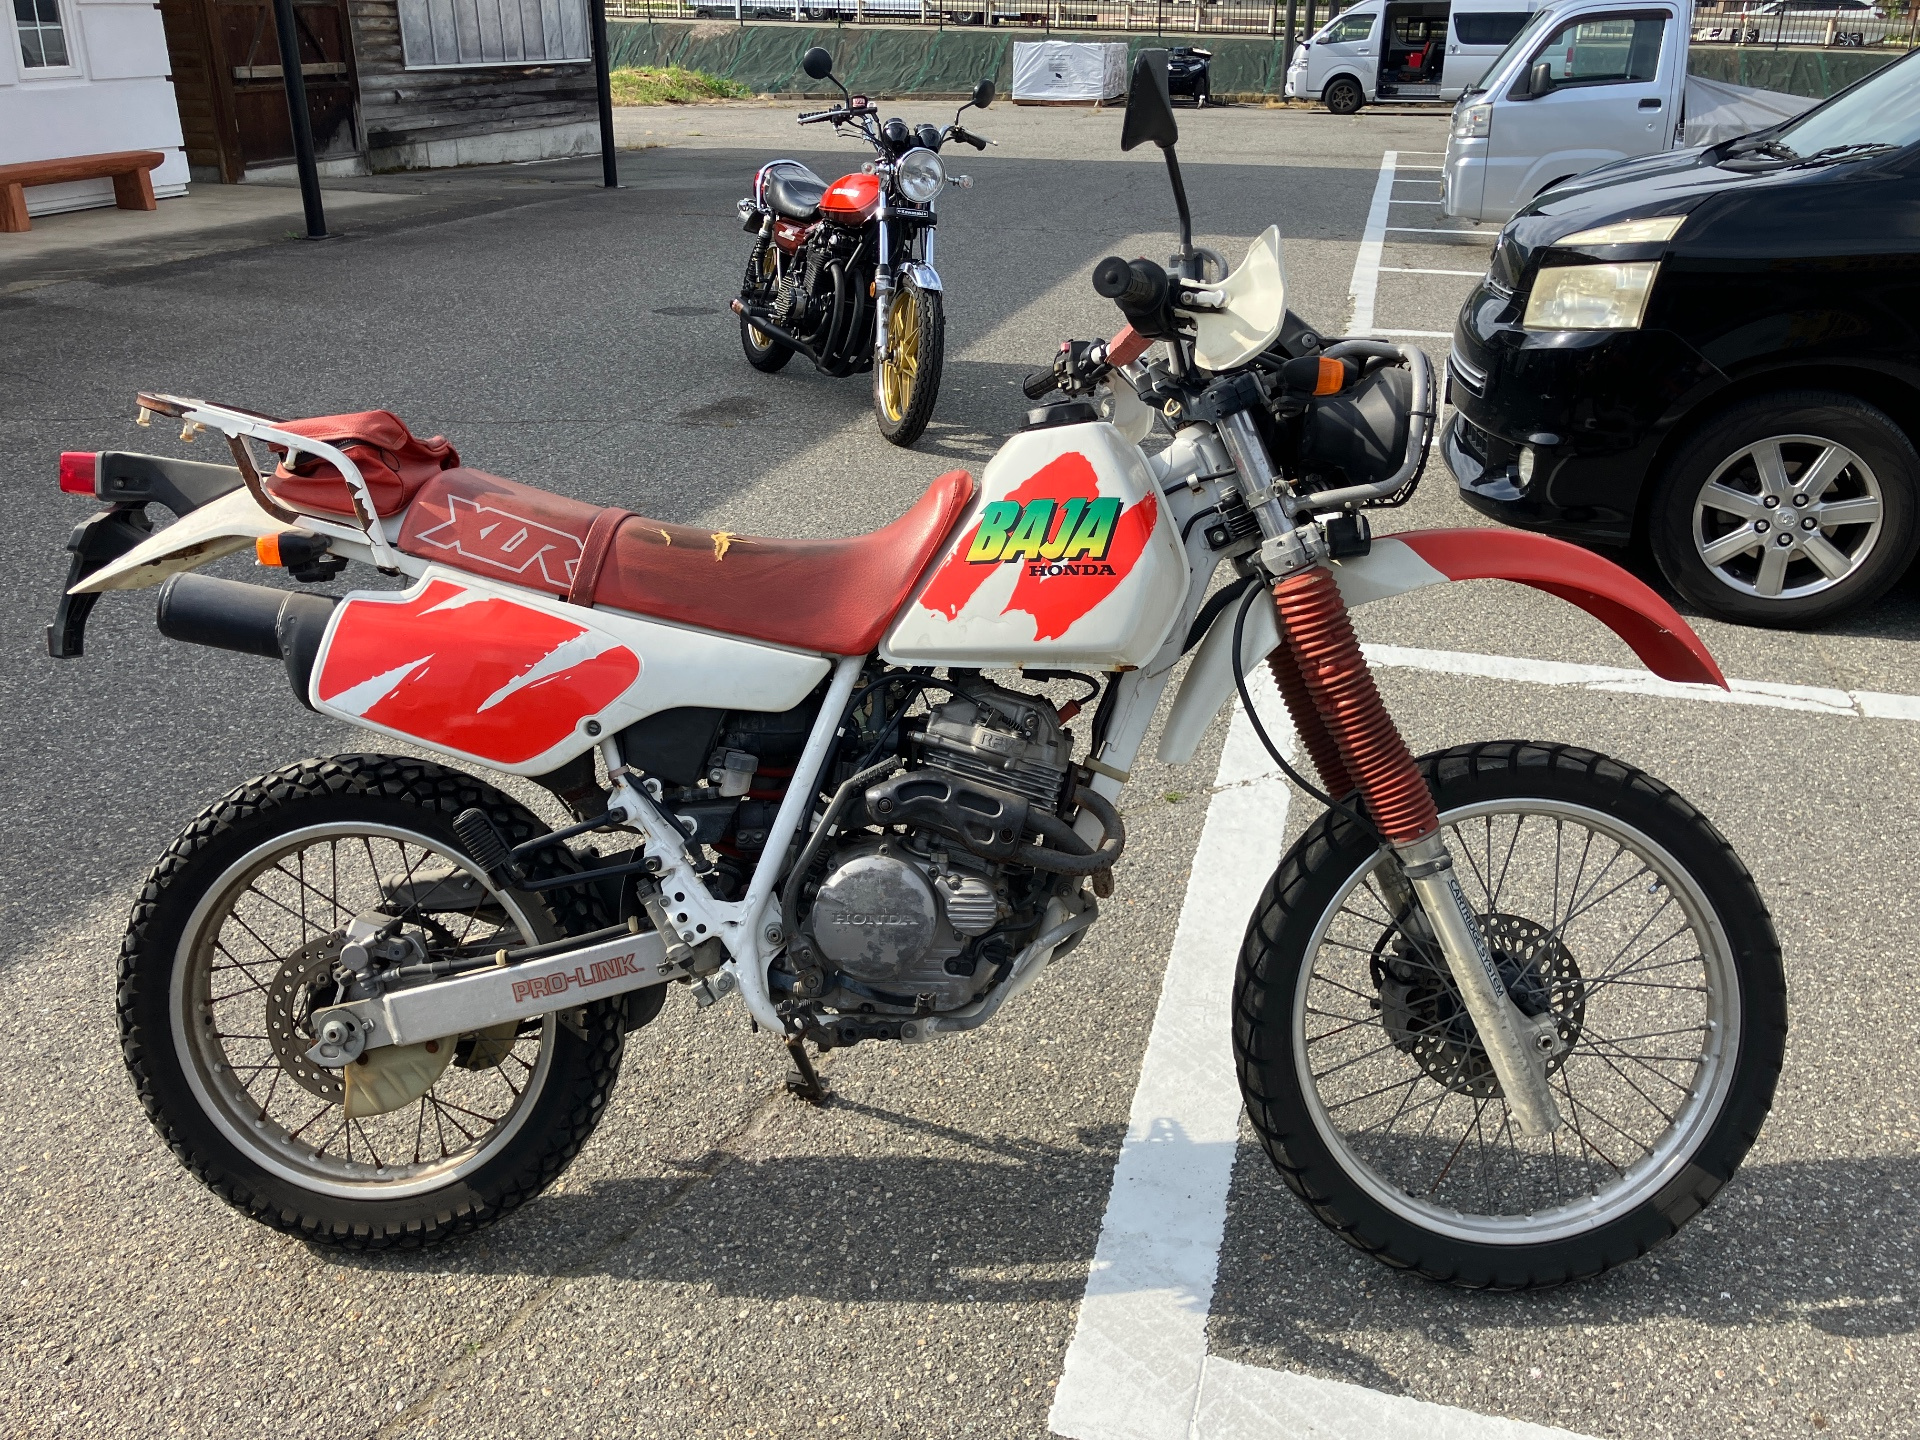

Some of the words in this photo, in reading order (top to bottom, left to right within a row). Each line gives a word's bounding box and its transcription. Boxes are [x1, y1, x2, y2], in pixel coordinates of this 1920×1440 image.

[964, 497, 1124, 565] BAJA
[1028, 565, 1116, 577] HONDA
[831, 912, 919, 926] HONDA
[1449, 879, 1484, 947] CARTRIDGE
[1479, 946, 1505, 998] SYSTEM
[511, 952, 640, 1003] PRO-LINK
